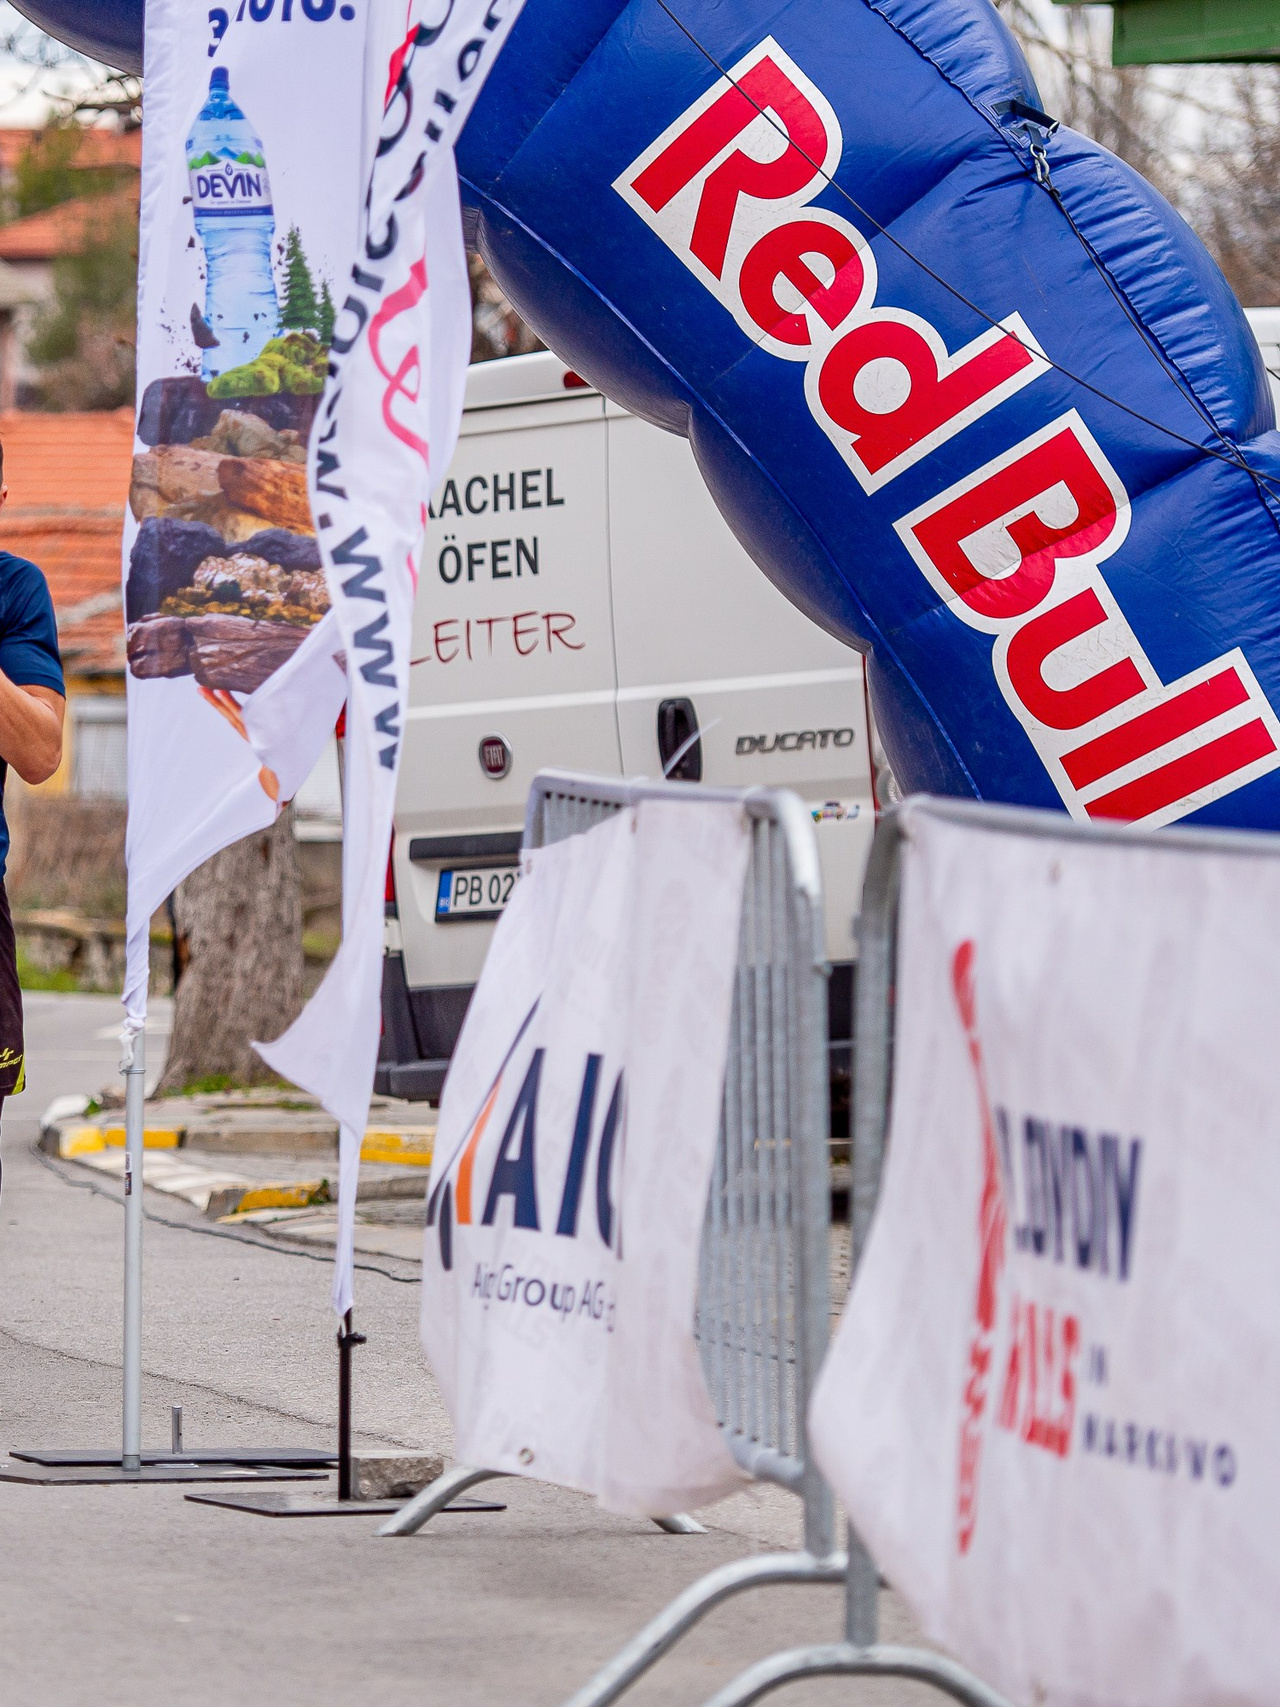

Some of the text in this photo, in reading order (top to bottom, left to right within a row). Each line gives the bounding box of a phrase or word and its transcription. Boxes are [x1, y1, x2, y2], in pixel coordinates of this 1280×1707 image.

[197, 172, 262, 198] DEVIN
[628, 52, 1278, 823] Red Bull
[427, 468, 565, 519] ACHEL
[438, 534, 540, 584] ÖFEN
[735, 728, 854, 756] DUCATO
[454, 872, 521, 907] PB 02
